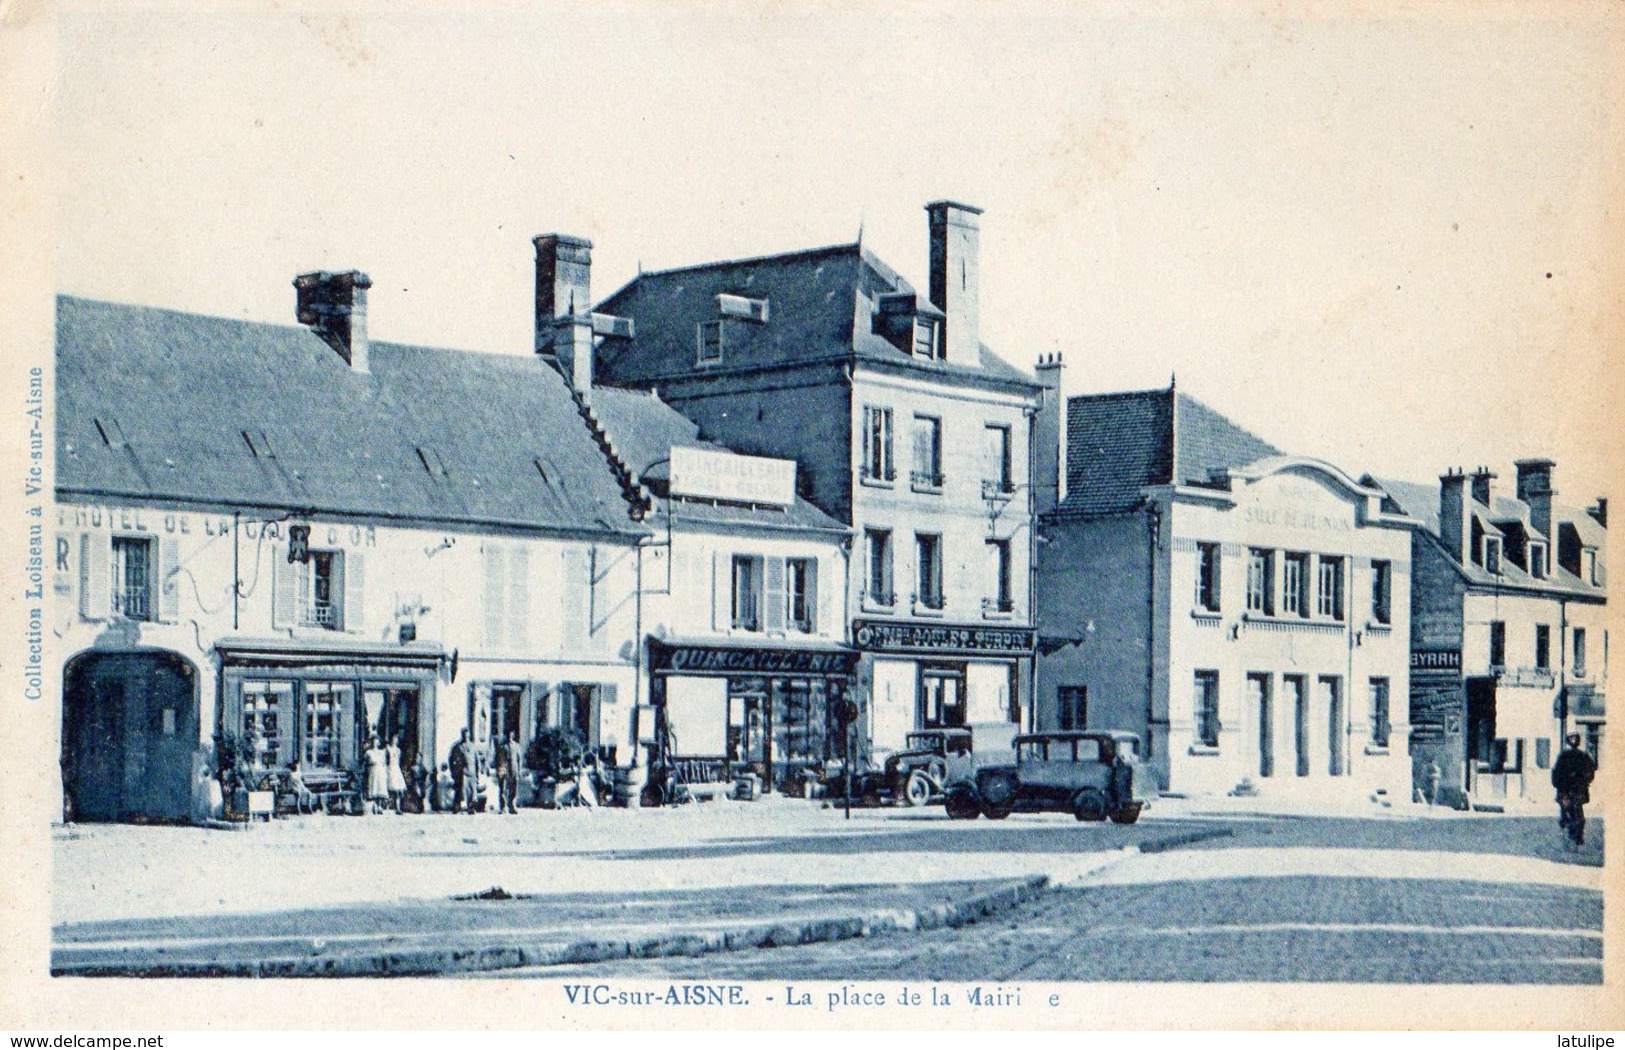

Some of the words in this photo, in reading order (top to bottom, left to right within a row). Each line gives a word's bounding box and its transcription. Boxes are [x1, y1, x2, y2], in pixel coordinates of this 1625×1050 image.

[164, 513, 190, 535] DE
[204, 516, 229, 537] LA
[671, 647, 845, 671] QUINCAILLERIE
[1409, 652, 1460, 666] BYRRH
